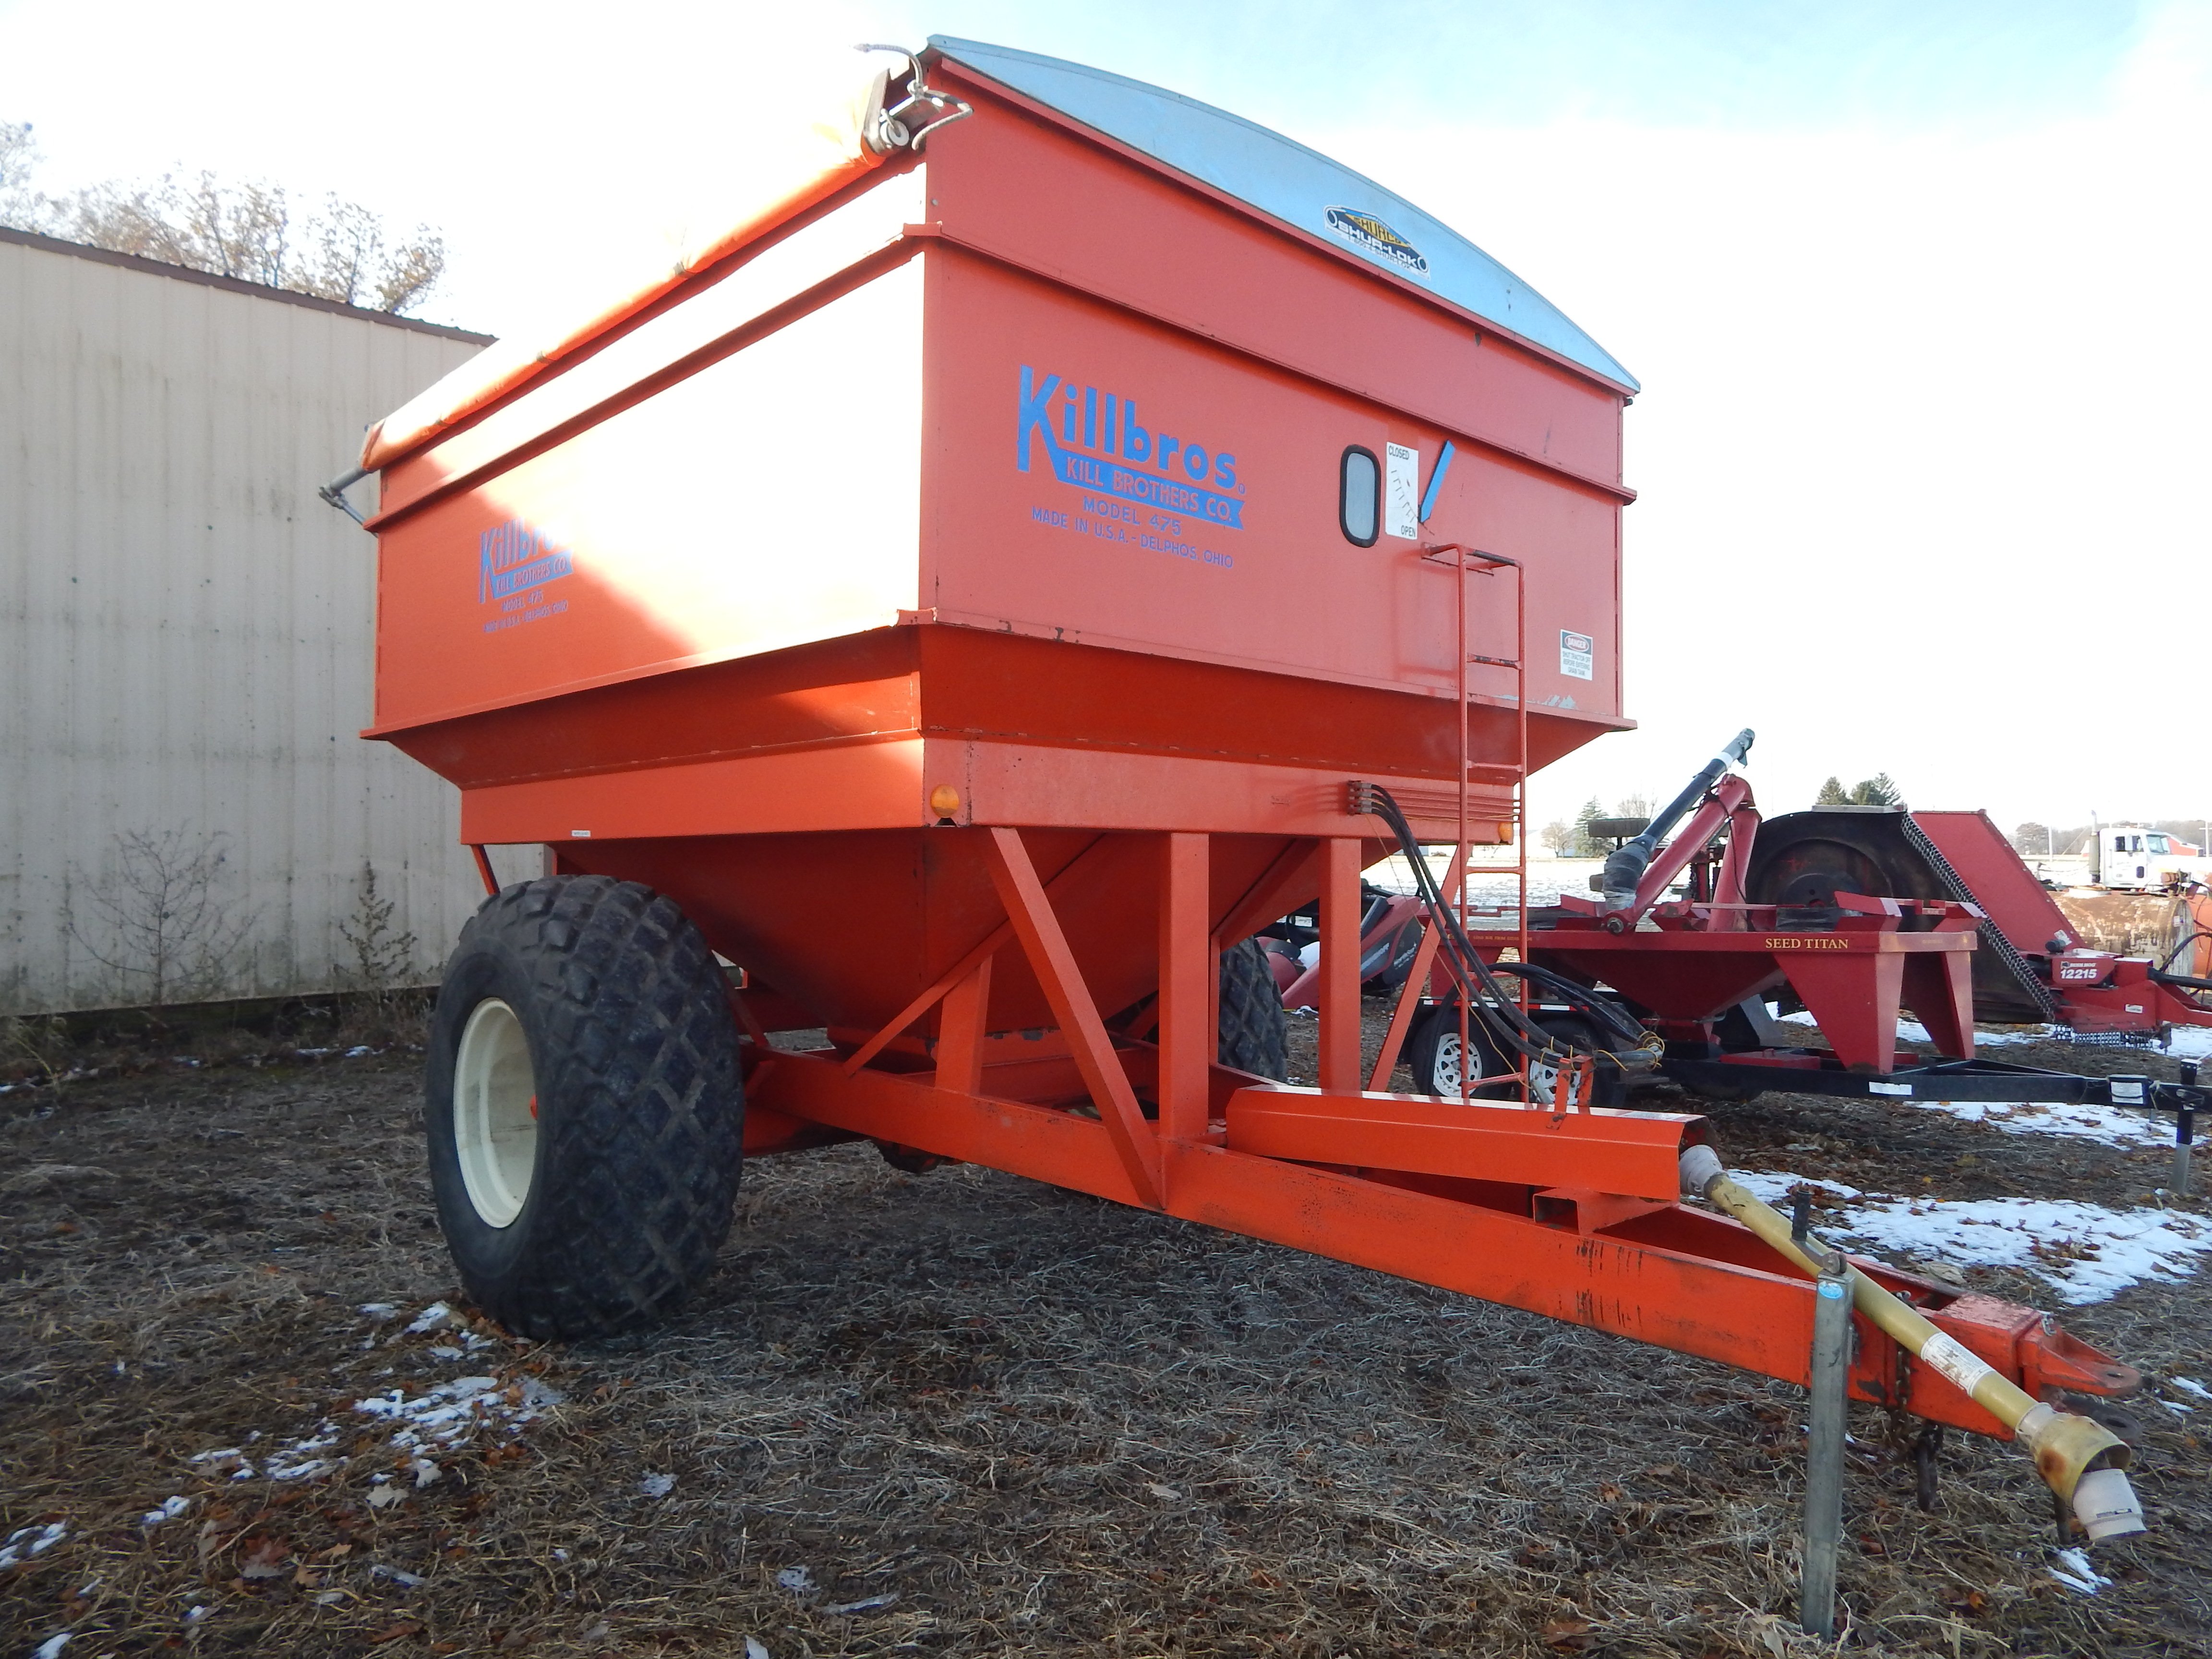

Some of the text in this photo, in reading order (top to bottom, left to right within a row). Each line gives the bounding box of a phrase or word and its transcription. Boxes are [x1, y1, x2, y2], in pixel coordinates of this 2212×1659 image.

[1388, 445, 1409, 459] CLOSED
[1067, 457, 1232, 521] KILL BROTHERS CO.
[1083, 495, 1181, 536] MODEL 475
[1032, 506, 1068, 529] MADE
[1074, 517, 1088, 533] IN
[1094, 522, 1128, 543] U.S.A.
[1203, 550, 1233, 568] OHIO
[1400, 525, 1416, 537] OPEN
[1765, 938, 1849, 949] SEED TITAN
[2060, 969, 2097, 978] 12215
